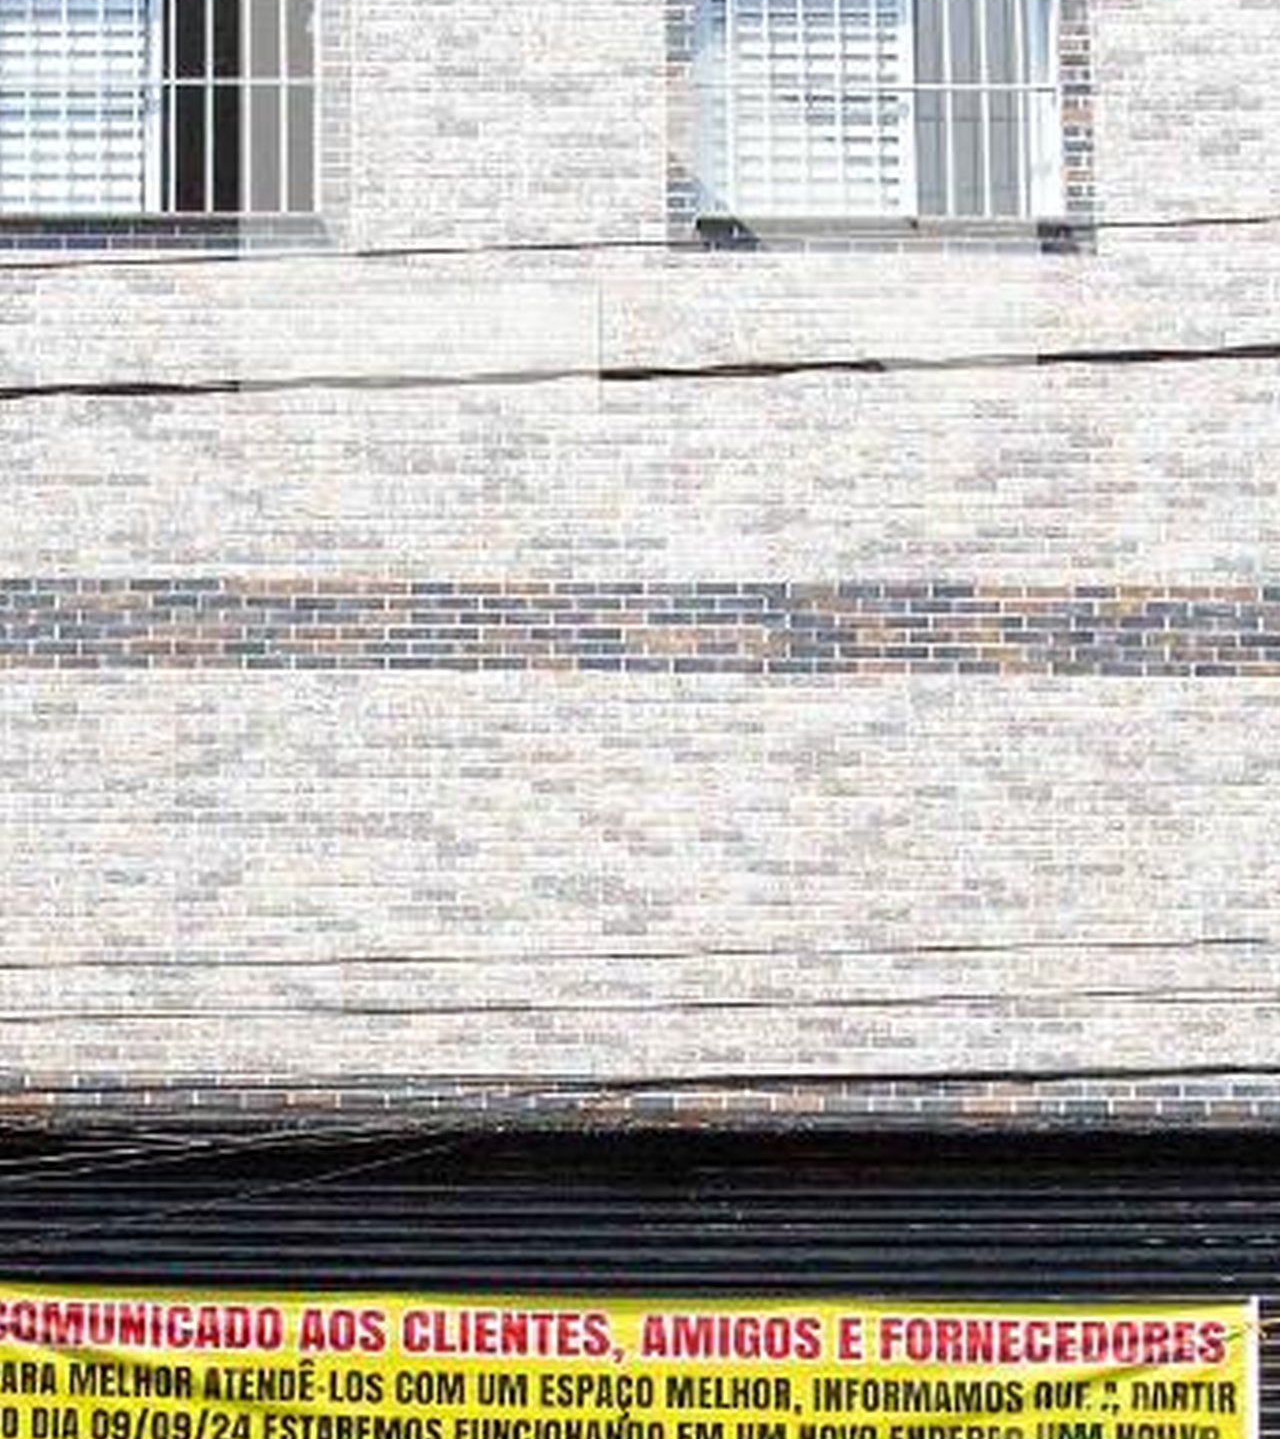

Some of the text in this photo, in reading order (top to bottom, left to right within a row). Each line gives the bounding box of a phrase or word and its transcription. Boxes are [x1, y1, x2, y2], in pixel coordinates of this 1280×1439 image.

[300, 1309, 386, 1353] AOS
[403, 1310, 625, 1364] CLIENTES,
[641, 1315, 822, 1359] AMIGOS
[838, 1318, 862, 1361] E
[878, 1317, 1226, 1364] FORNECEDORES
[70, 1362, 192, 1399] MELHOR
[203, 1359, 384, 1404] ATENDÊ-LOS
[395, 1372, 465, 1406] COM
[477, 1373, 528, 1407] UM
[540, 1374, 654, 1420] ESPAÇO
[666, 1375, 803, 1415] MELHOR,
[813, 1378, 1024, 1413] INFORMAMOS
